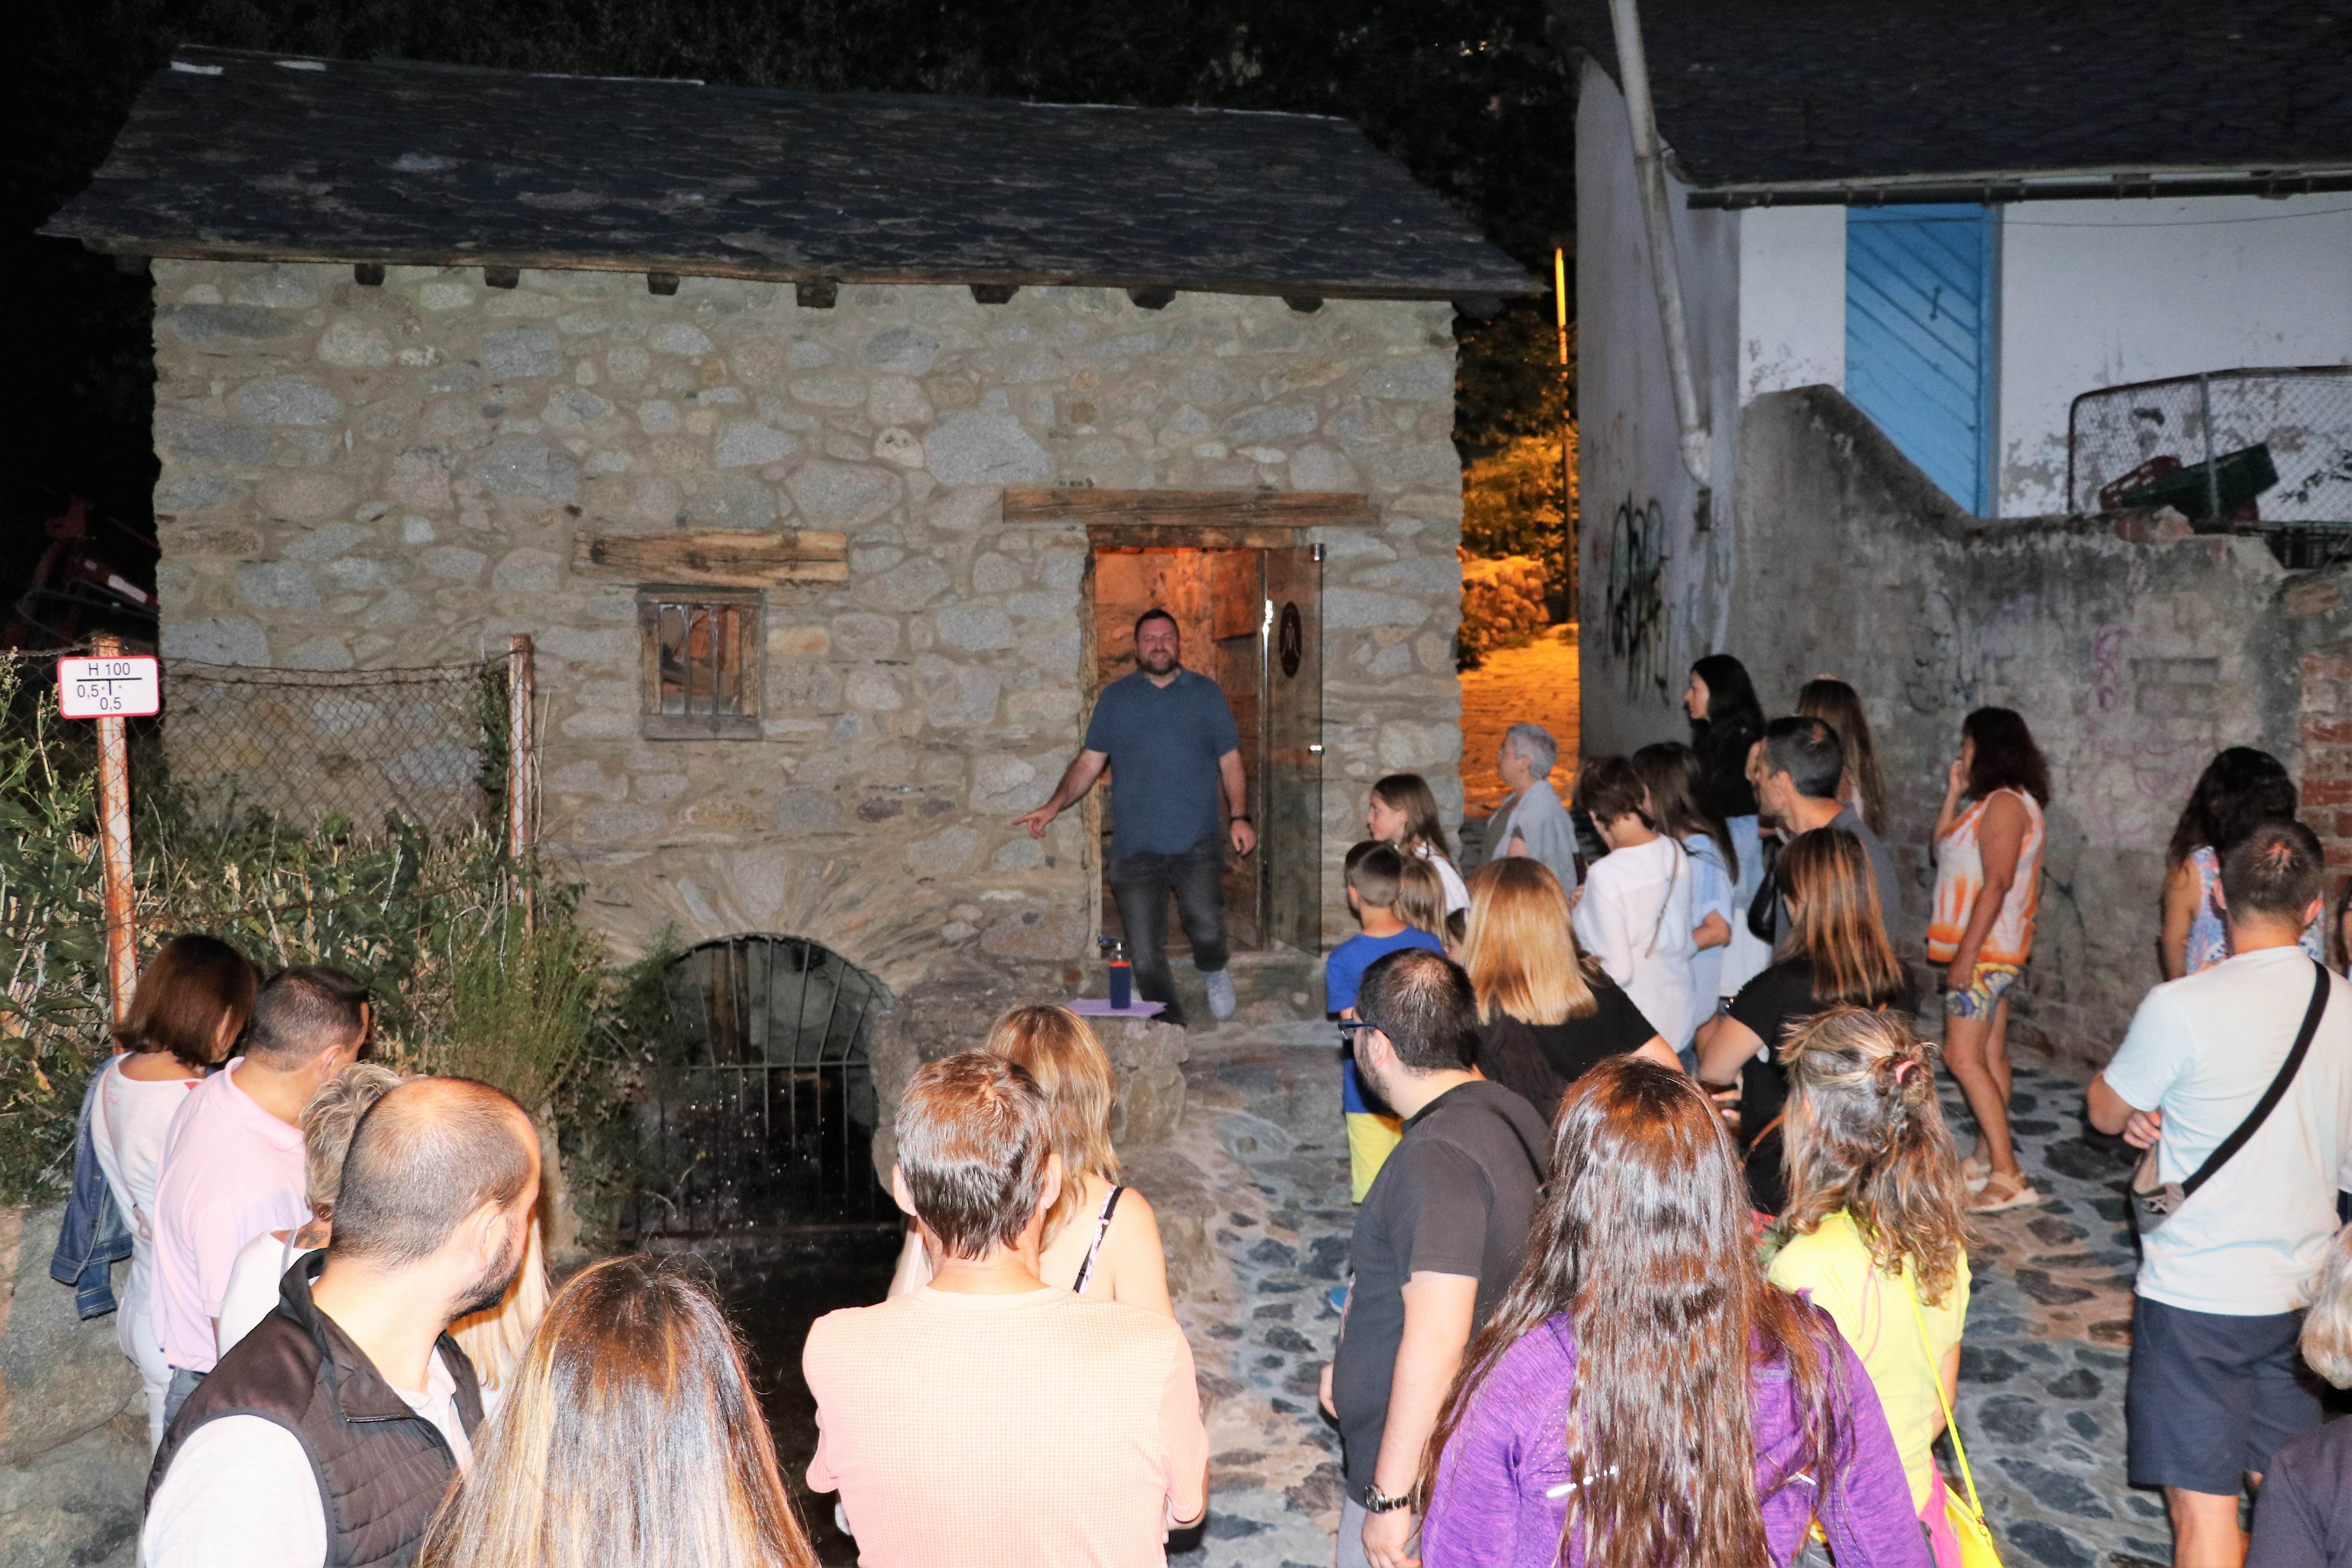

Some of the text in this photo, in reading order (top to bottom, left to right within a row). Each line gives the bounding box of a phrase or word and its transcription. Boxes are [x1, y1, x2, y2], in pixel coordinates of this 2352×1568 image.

[88, 662, 130, 676] H 100
[77, 684, 99, 700] 0,5
[100, 697, 121, 712] 0,5
